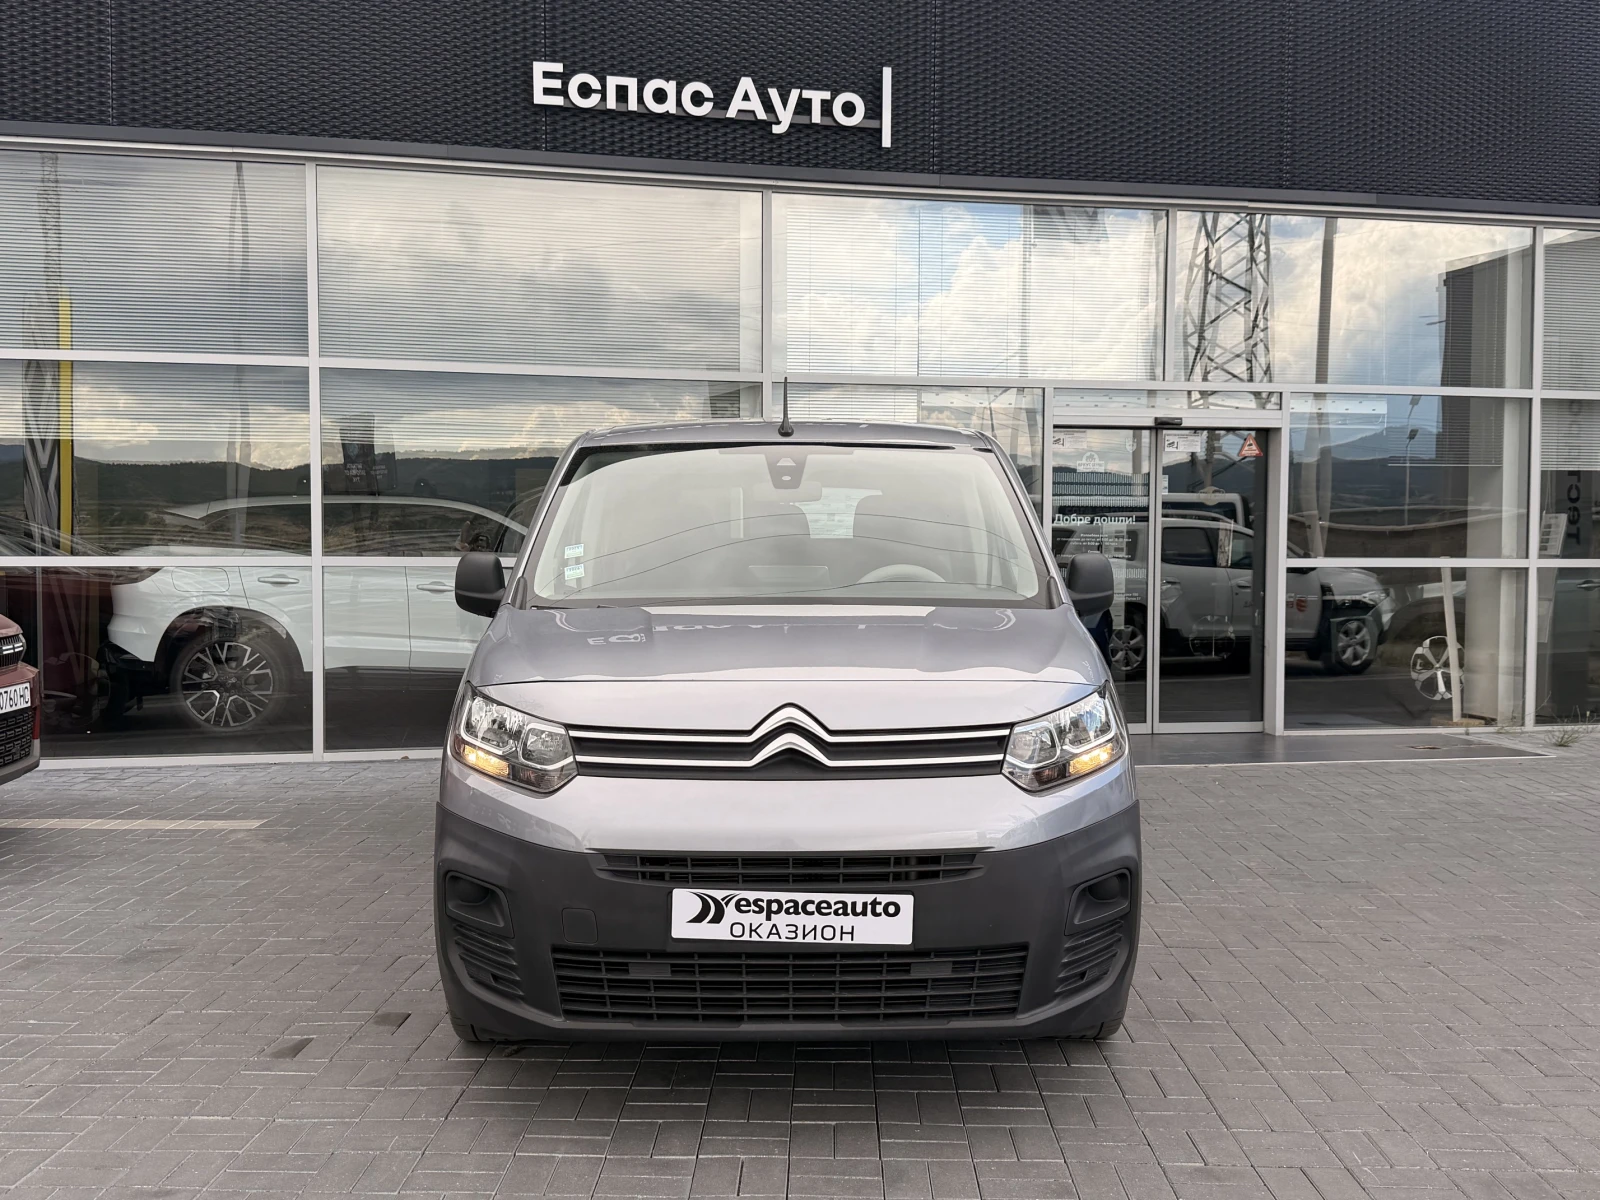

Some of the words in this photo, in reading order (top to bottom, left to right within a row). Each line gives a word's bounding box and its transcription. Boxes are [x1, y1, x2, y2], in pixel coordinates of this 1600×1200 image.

[532, 61, 714, 117] Еспас
[726, 76, 866, 135] Ауто
[1054, 513, 1091, 526] Добре
[1093, 514, 1136, 526] дошли!
[734, 896, 901, 921] espaceauto
[730, 922, 855, 941] ОКАЗИОН
